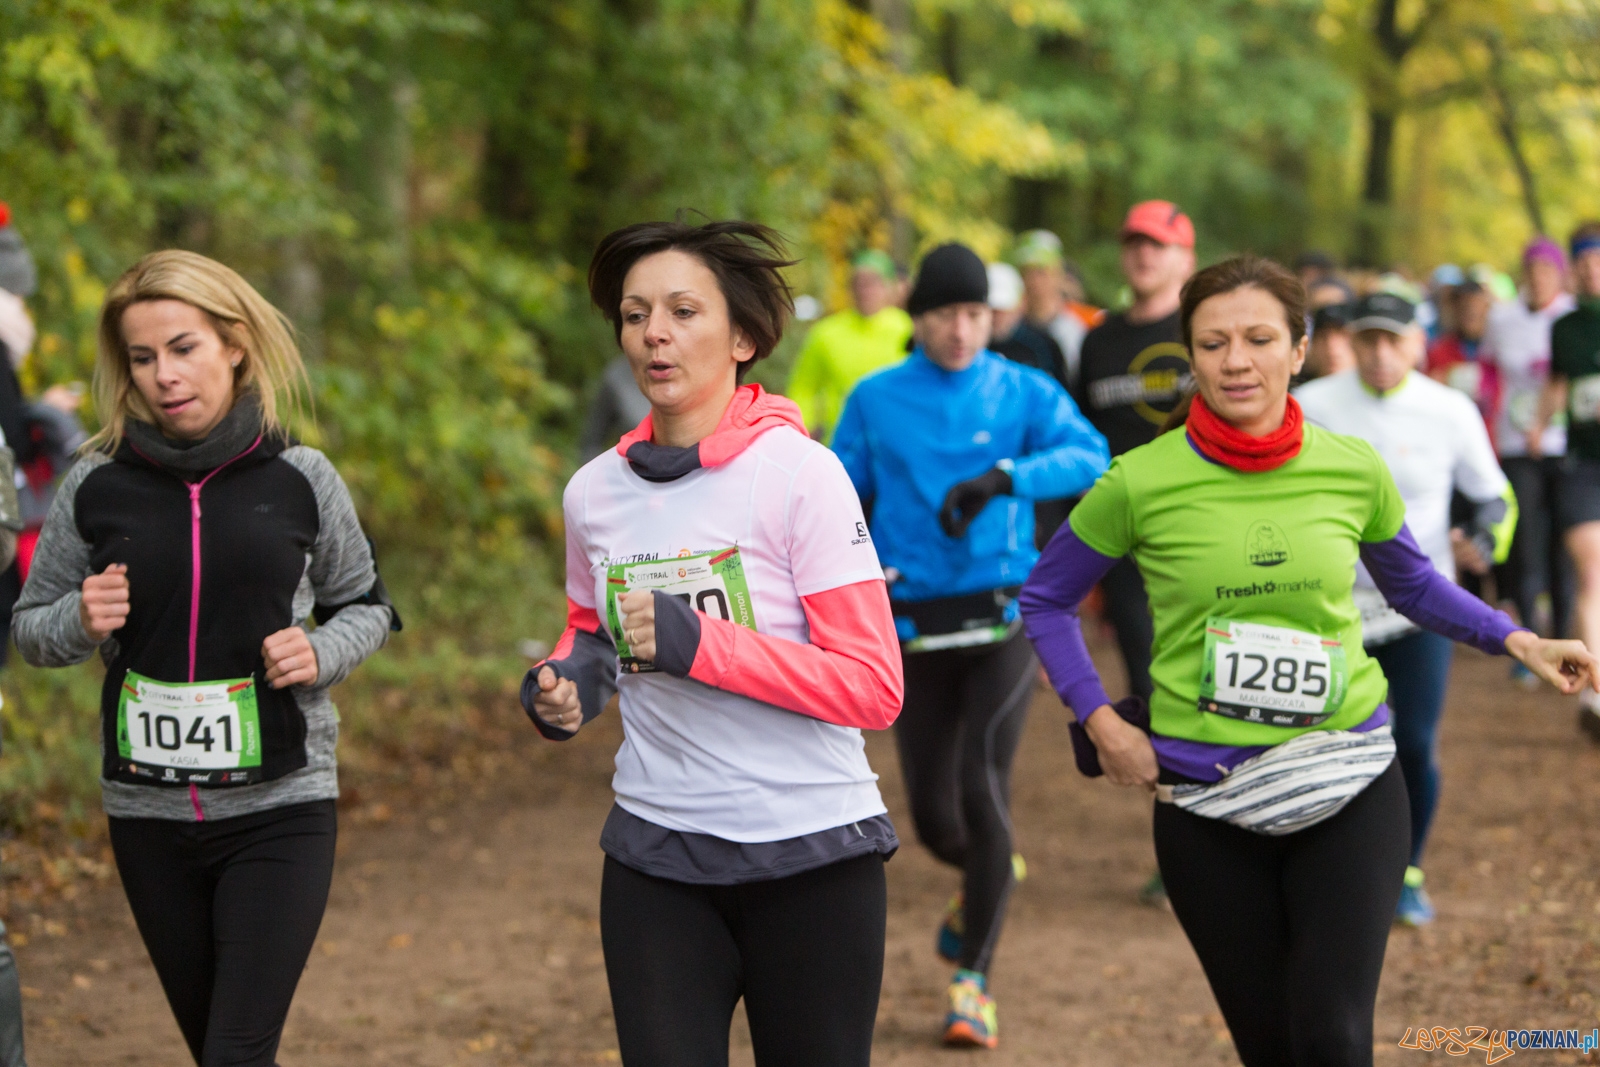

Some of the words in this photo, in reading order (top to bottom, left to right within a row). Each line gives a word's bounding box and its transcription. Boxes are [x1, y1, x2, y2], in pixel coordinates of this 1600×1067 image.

[1216, 582, 1263, 599] Fresh
[1278, 578, 1322, 593] market
[1225, 652, 1327, 697] 1285
[1239, 694, 1306, 709] MAŁGORZATA
[138, 711, 233, 752] 1041
[170, 756, 199, 765] KASIA
